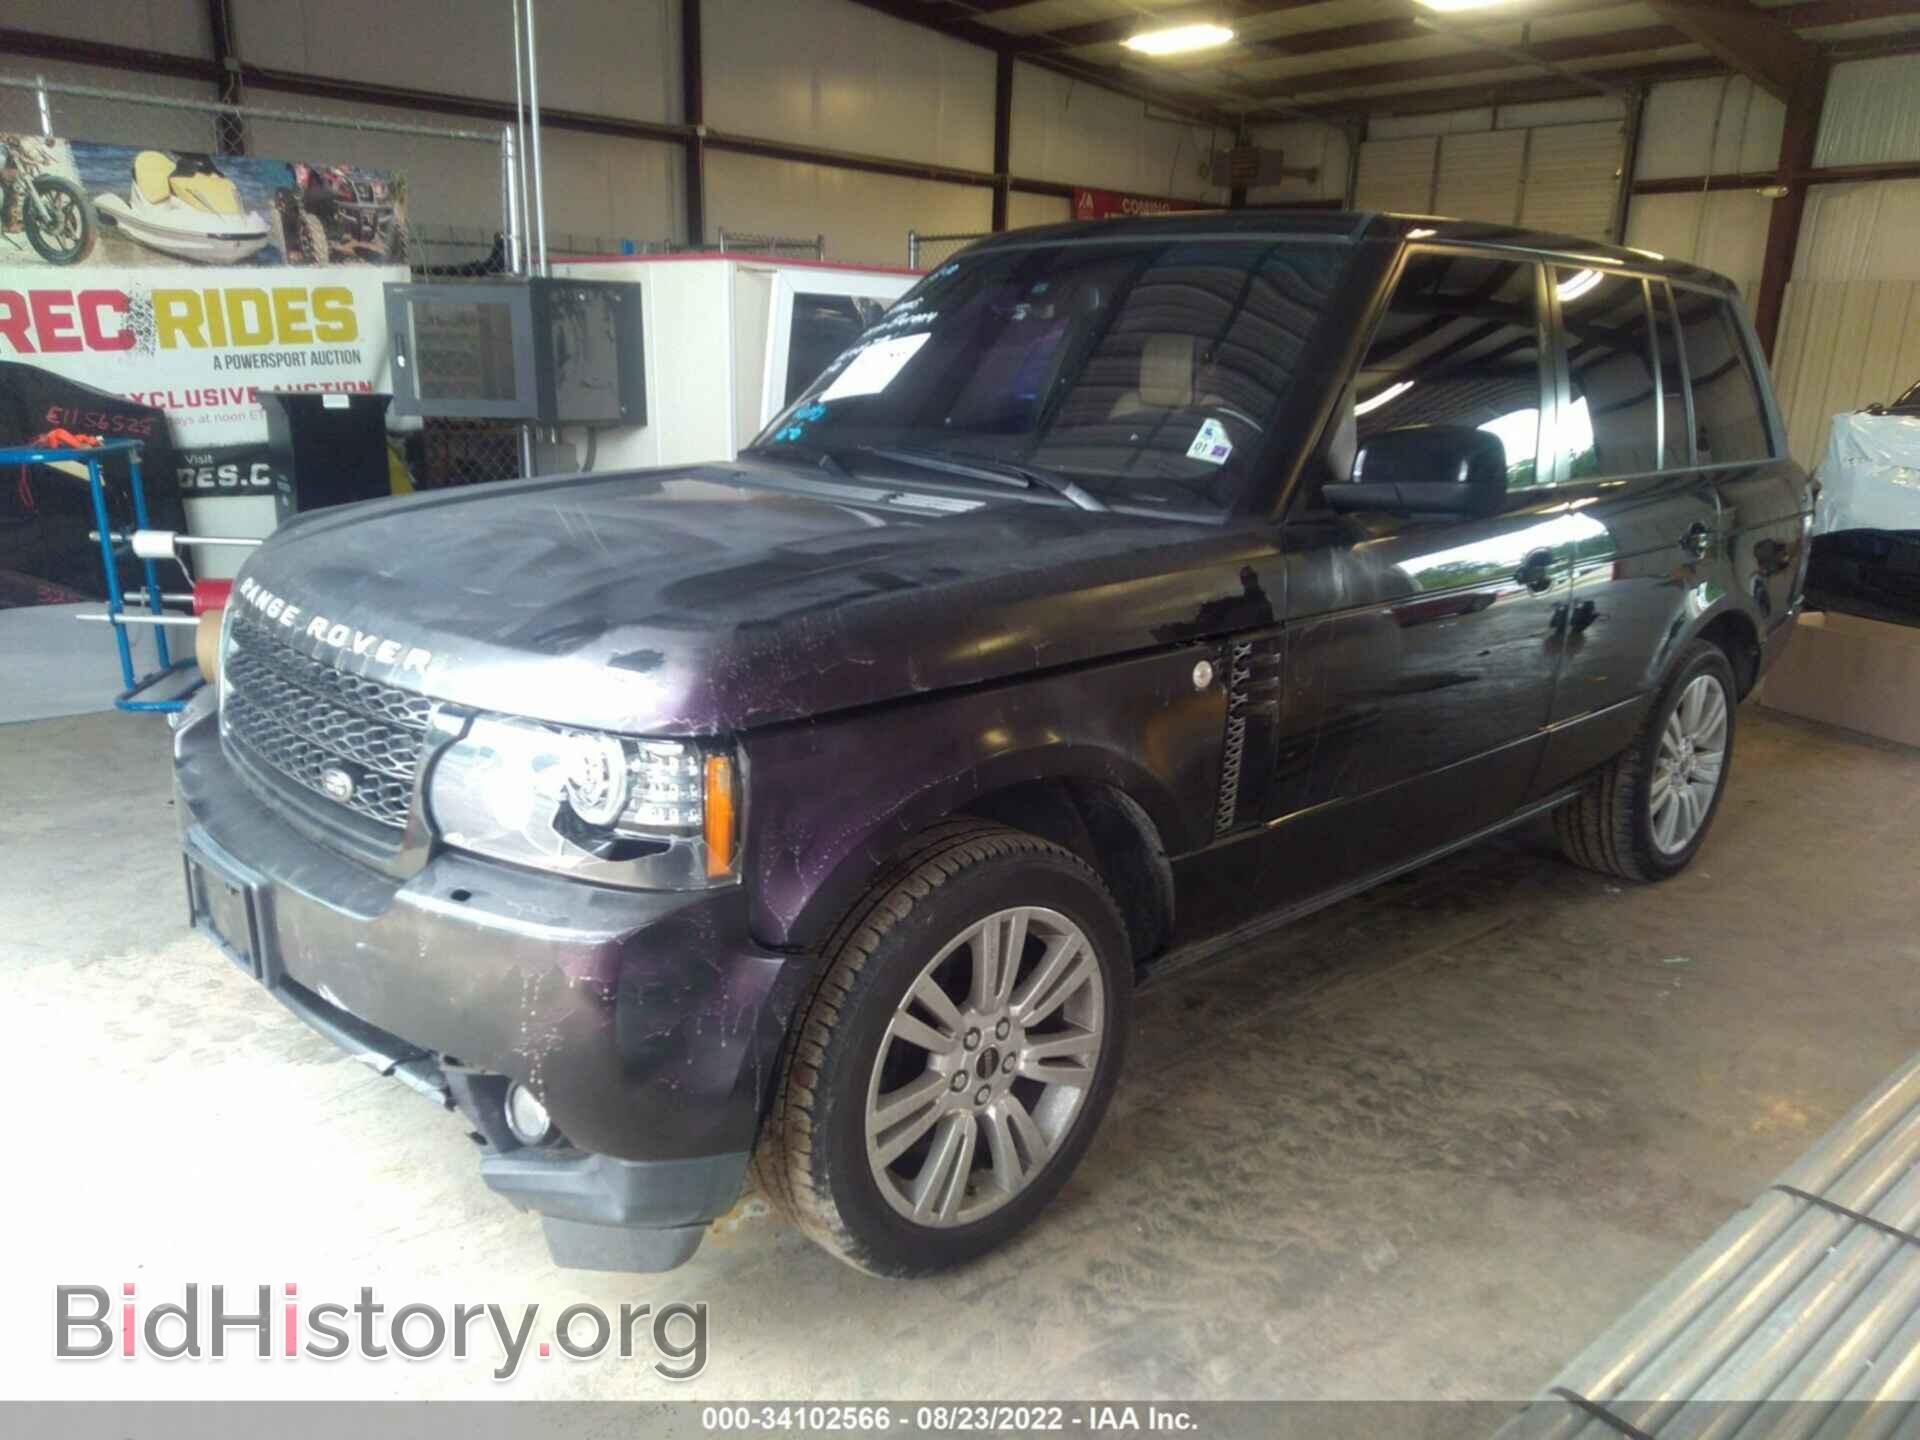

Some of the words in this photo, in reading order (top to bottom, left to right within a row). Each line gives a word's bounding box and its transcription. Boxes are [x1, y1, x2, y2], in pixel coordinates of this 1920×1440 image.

[0, 288, 137, 353] REC
[151, 286, 359, 350] RIDES
[213, 354, 223, 371] A
[225, 350, 308, 370] POWERSPORT
[310, 349, 362, 367] AUCTION
[118, 385, 259, 409] XCLUSIVE
[239, 577, 300, 627] RANGE
[306, 615, 433, 673] ROVER
